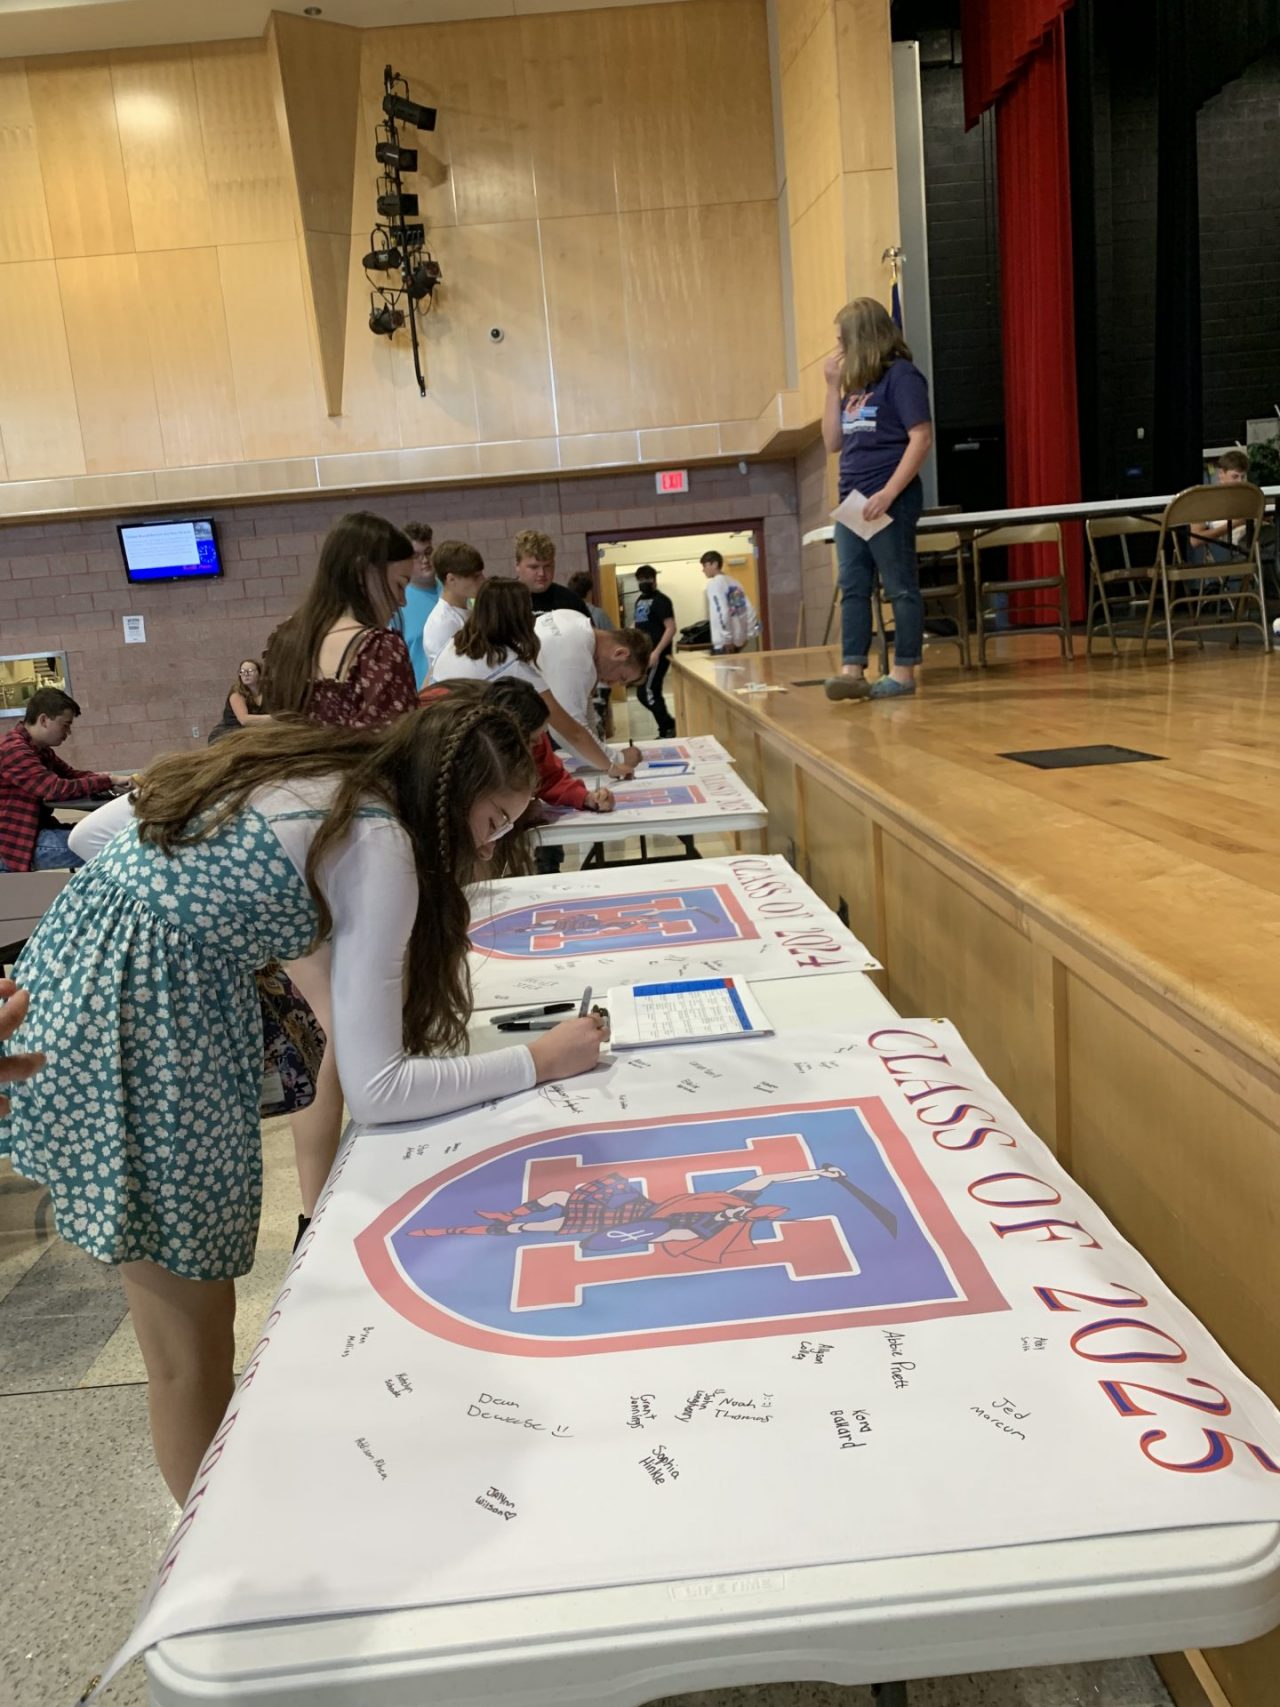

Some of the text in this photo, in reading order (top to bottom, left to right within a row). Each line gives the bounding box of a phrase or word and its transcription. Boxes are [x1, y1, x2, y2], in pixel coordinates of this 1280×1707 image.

[728, 859, 792, 899] CLASS
[774, 927, 852, 967] 2024
[867, 1029, 1280, 1473] CLASS OF 2025
[881, 1329, 906, 1357] Abbie
[639, 1394, 657, 1420] Grant
[714, 1408, 774, 1423] Thomas
[718, 1398, 756, 1409] Noah
[991, 1396, 1032, 1420] Jed
[638, 1456, 665, 1486] Hinkle
[651, 1444, 680, 1480] Sophia
[474, 1495, 503, 1517] Wilson
